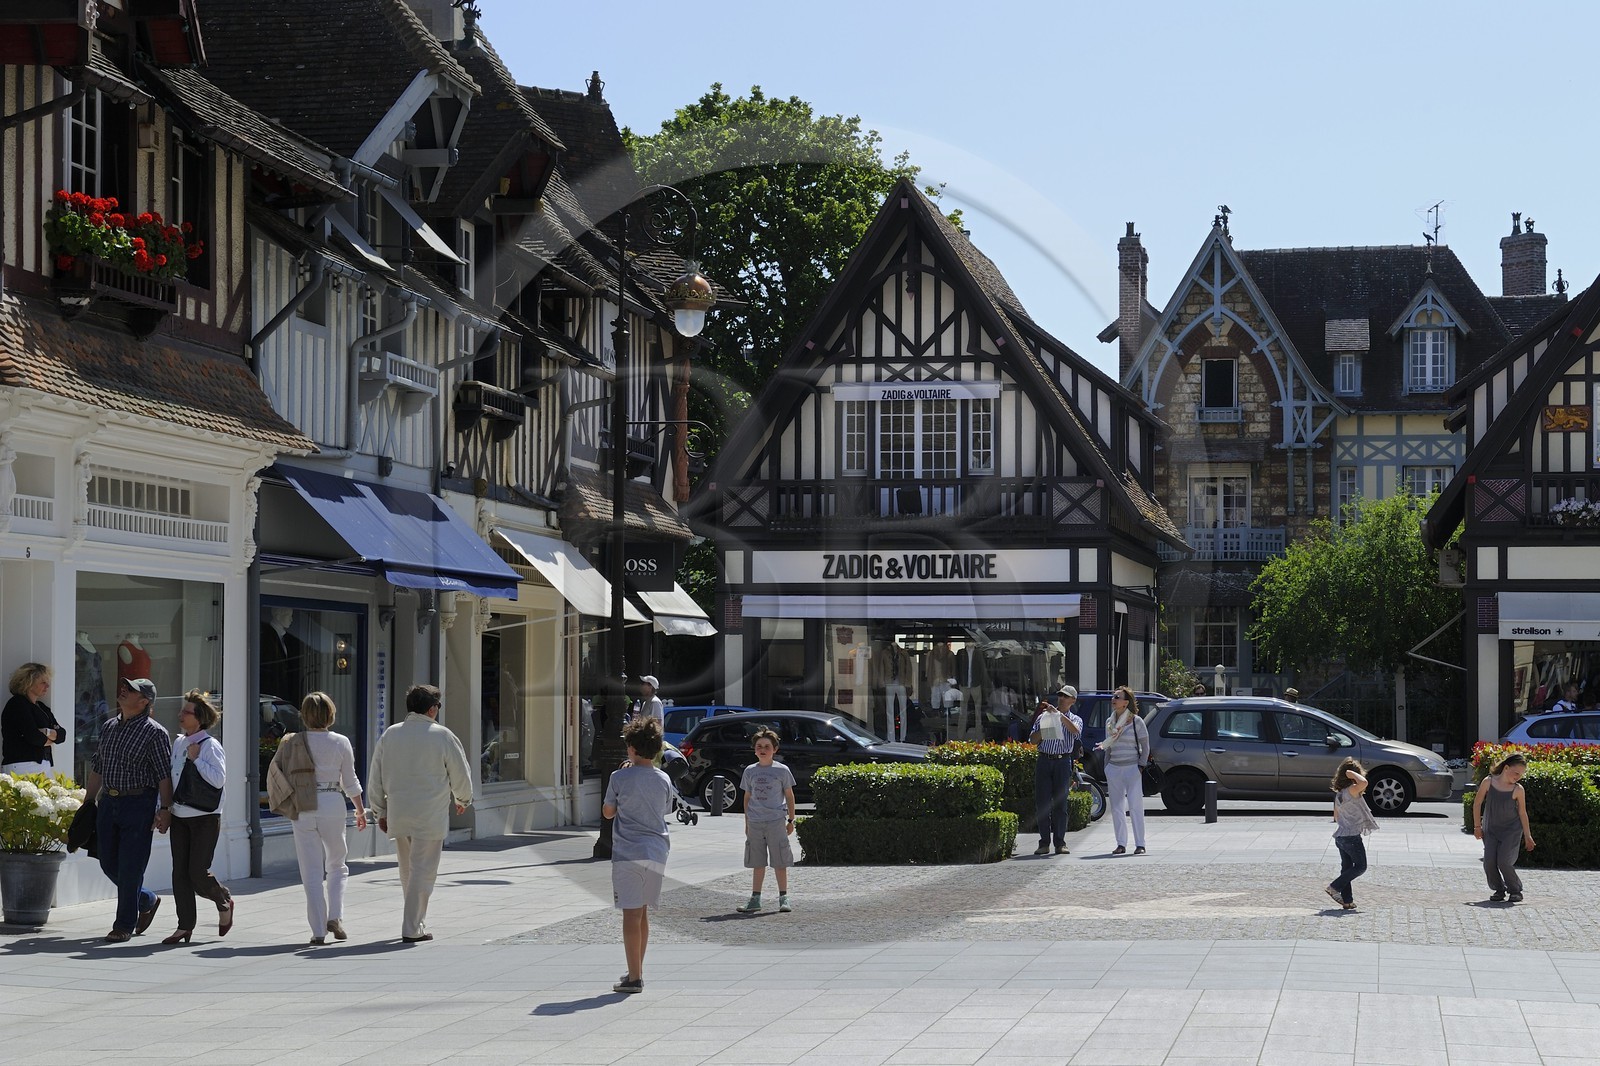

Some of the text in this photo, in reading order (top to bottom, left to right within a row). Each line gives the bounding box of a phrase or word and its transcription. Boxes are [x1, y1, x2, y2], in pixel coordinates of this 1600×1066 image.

[881, 389, 952, 400] ZADIG&VOLTAIRE
[25, 546, 31, 559] 5
[624, 558, 657, 571] OSS
[822, 554, 997, 579] ZADIG&VOLTAIRE
[1511, 627, 1551, 635] strellson
